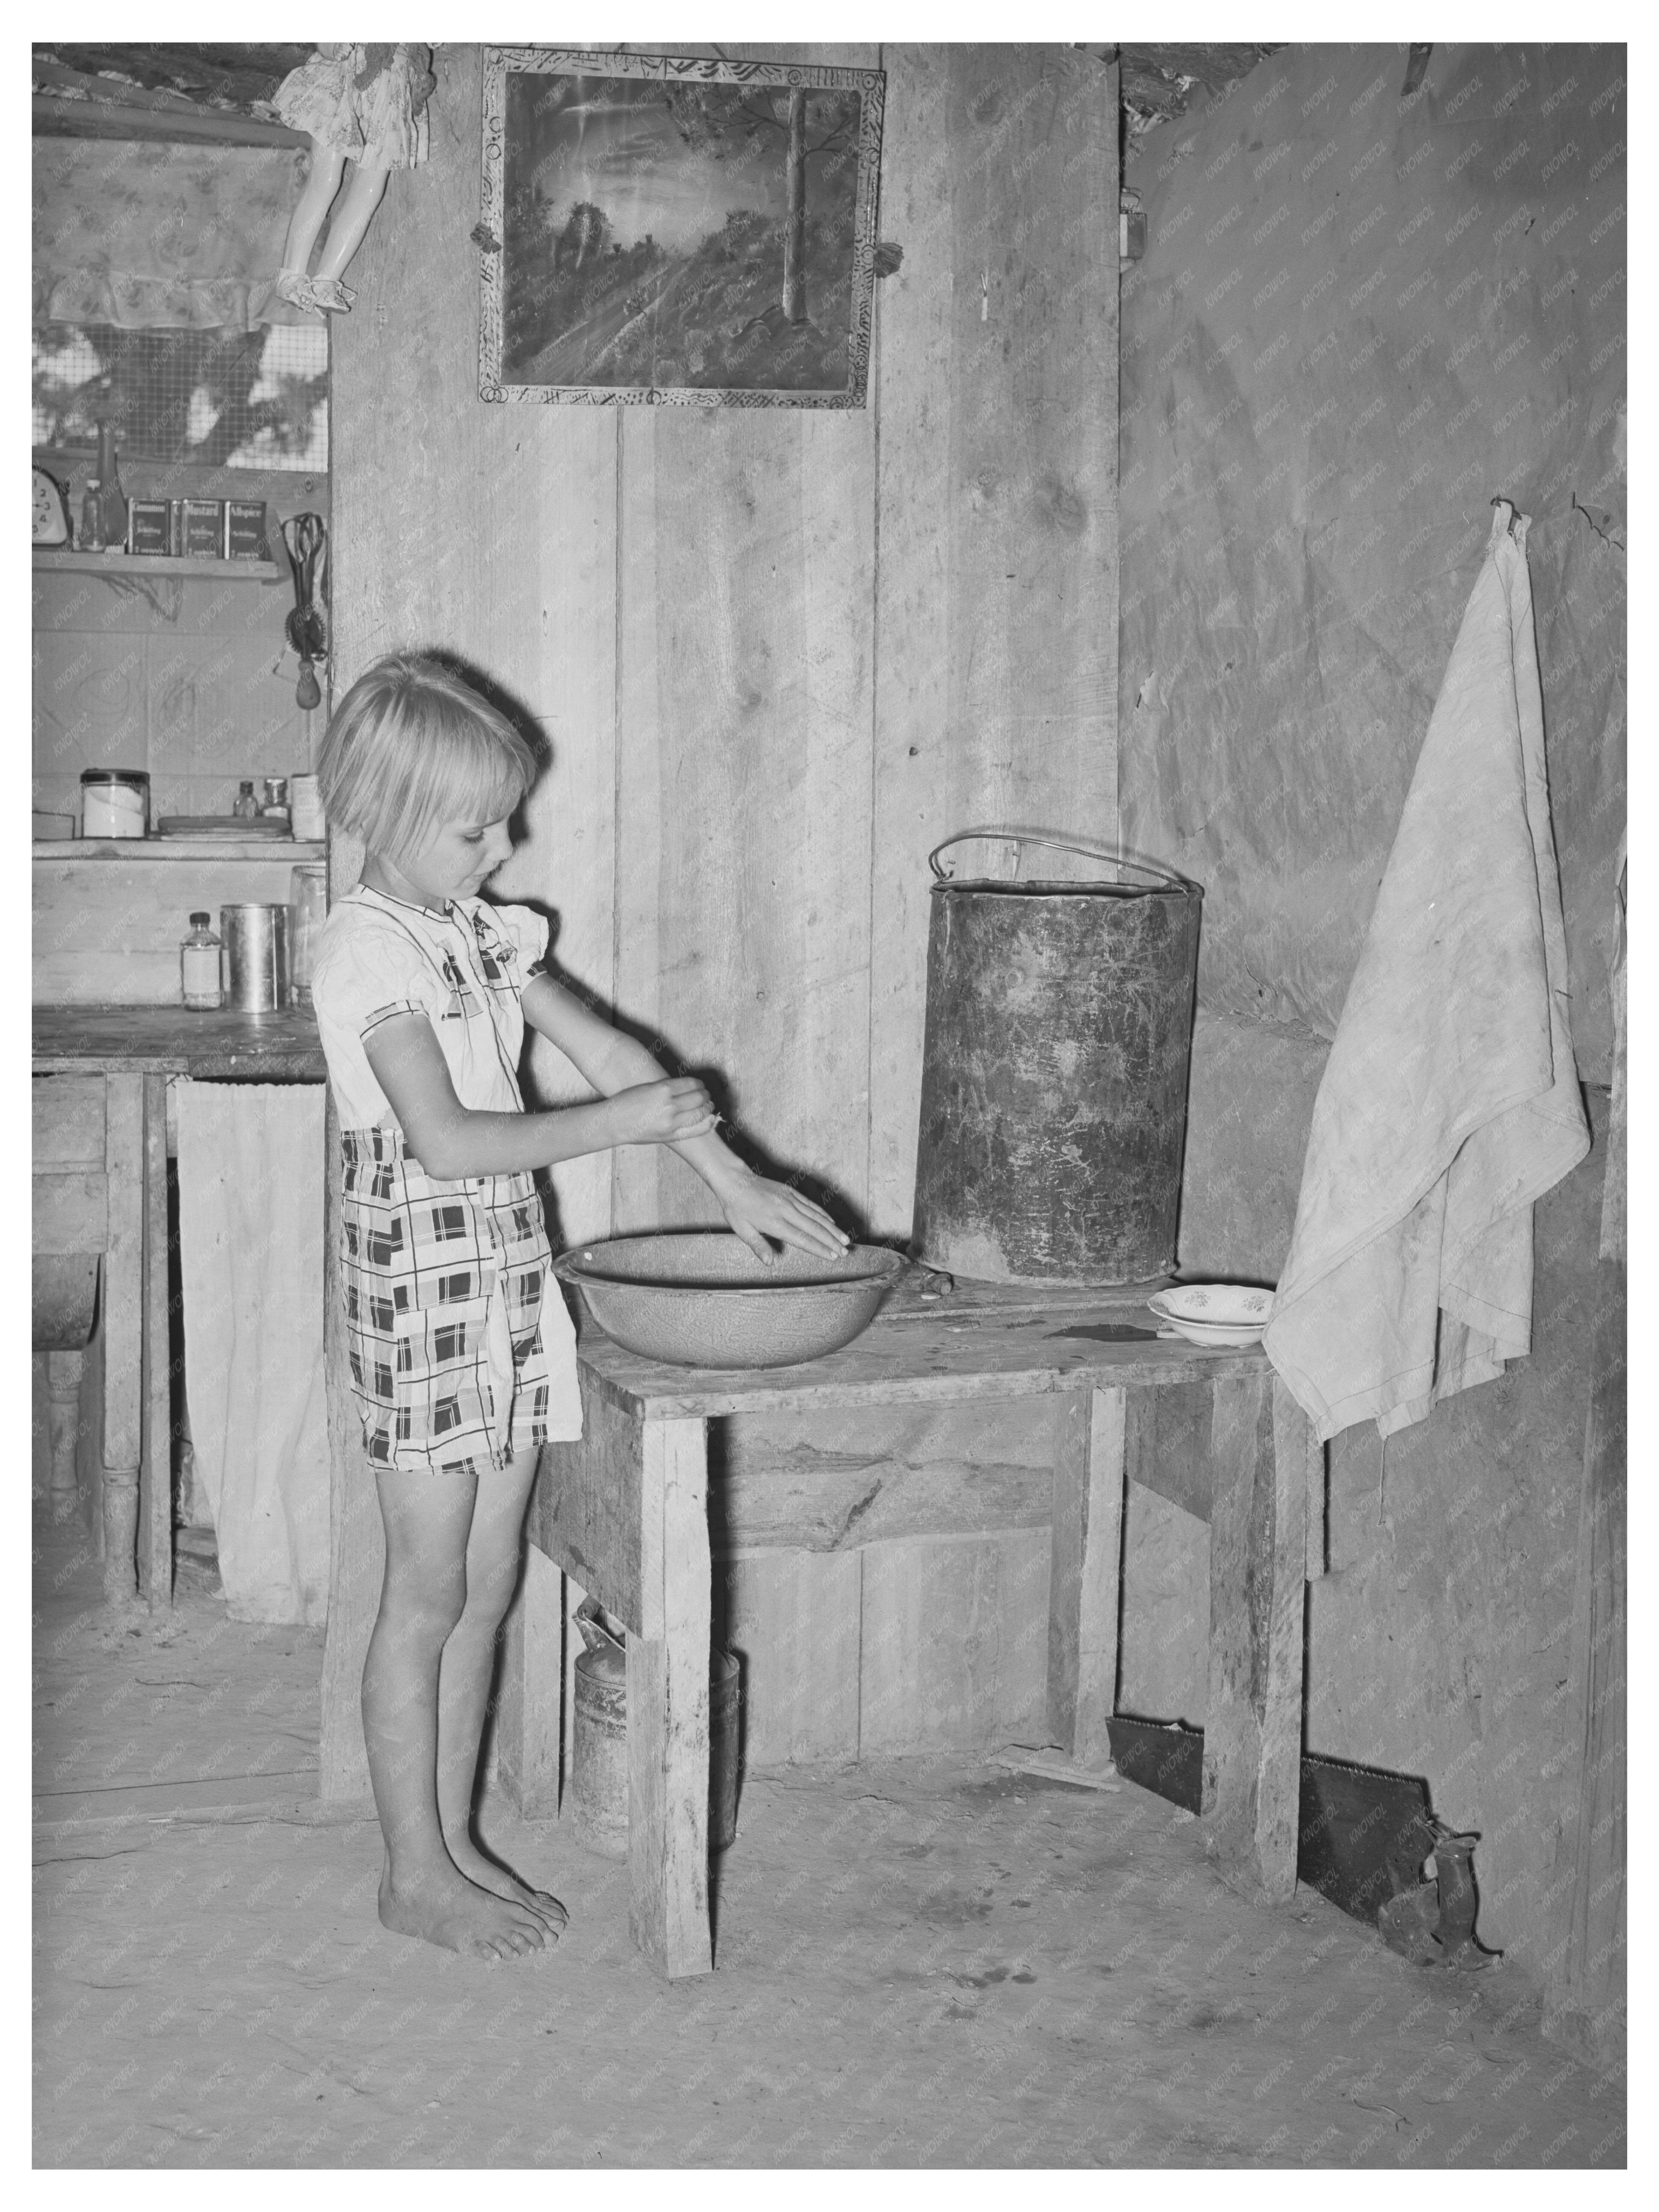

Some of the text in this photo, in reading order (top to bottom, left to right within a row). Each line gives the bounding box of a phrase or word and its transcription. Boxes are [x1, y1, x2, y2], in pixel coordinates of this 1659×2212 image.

[40, 489, 46, 498] 2
[44, 502, 51, 511] 3
[187, 503, 219, 516] Mustard
[230, 506, 262, 518] Allspice
[39, 514, 47, 523] 4
